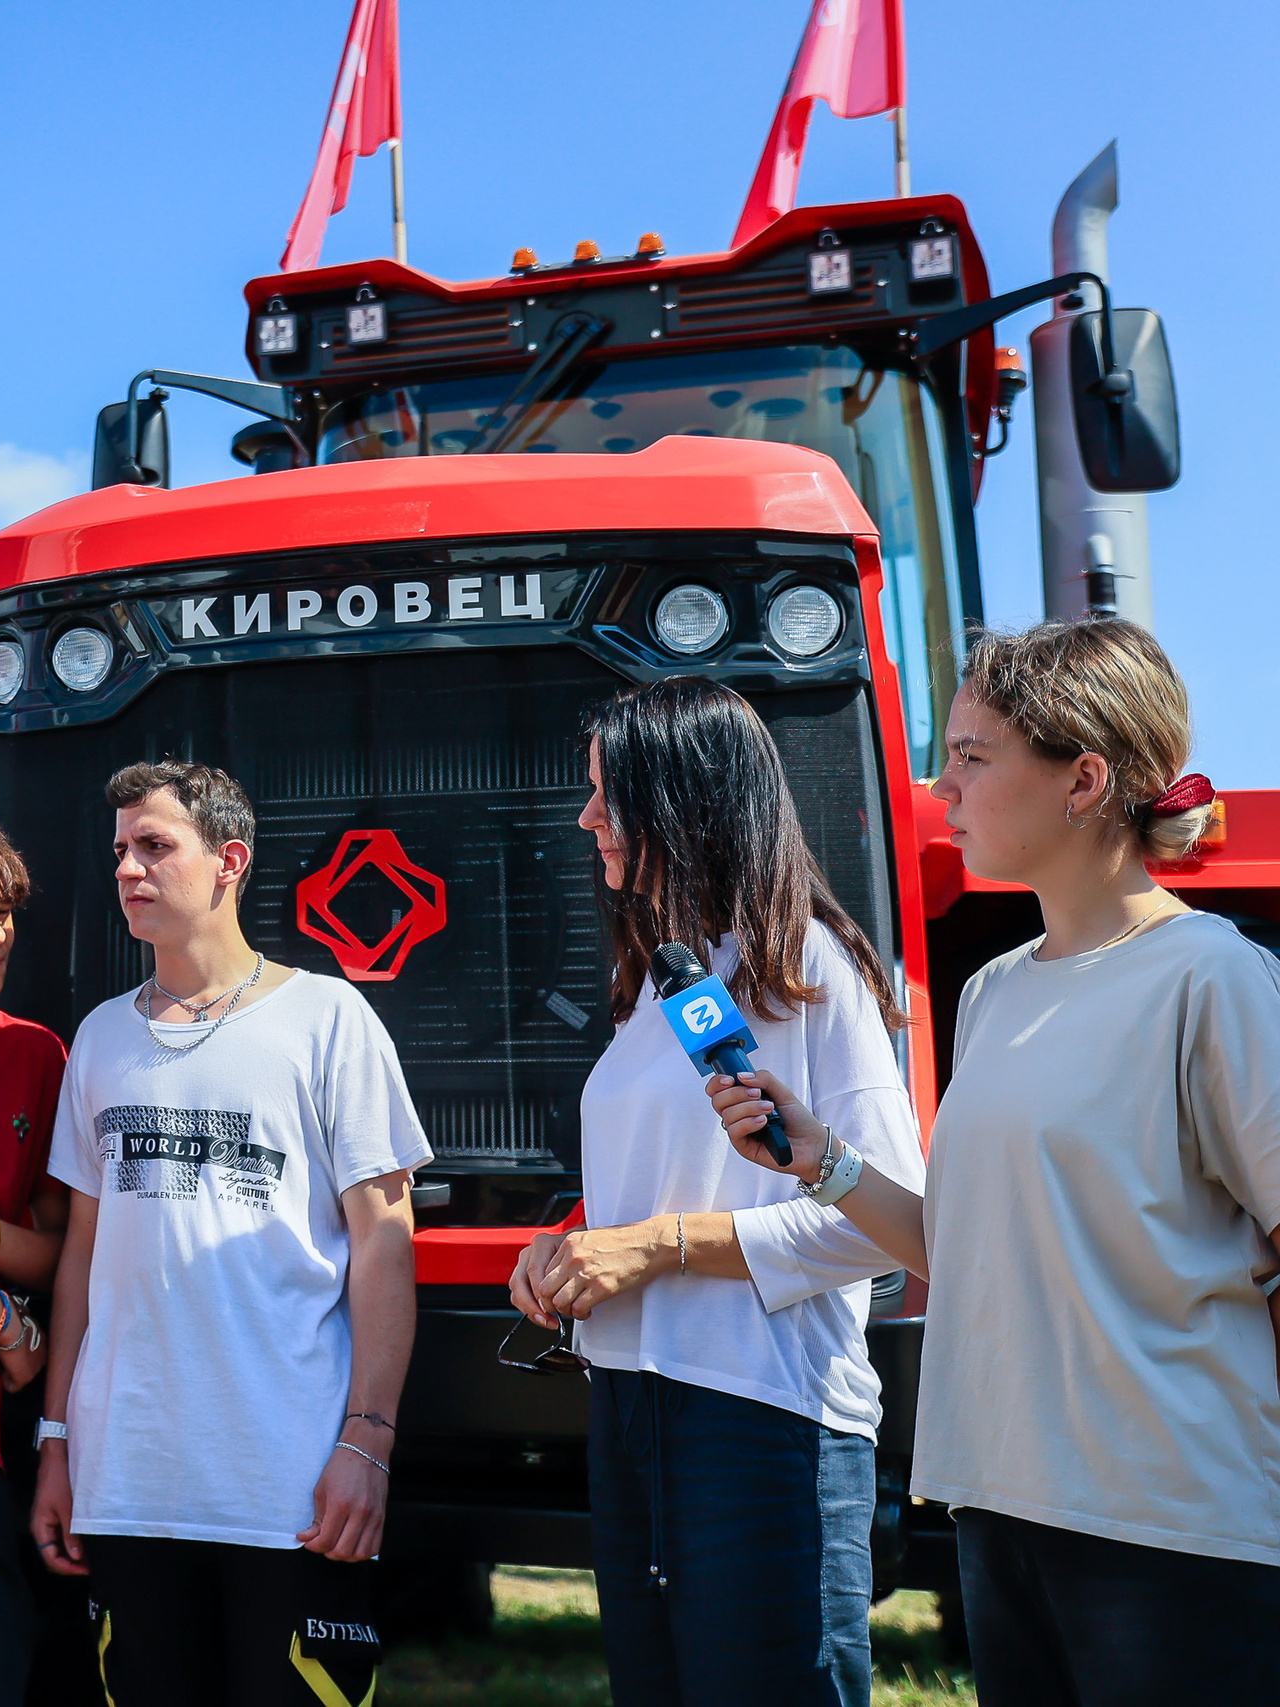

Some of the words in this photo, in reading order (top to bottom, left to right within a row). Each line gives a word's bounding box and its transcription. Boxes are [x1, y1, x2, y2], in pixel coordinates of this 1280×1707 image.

[181, 573, 546, 639] КИРОВЕЦ
[130, 1137, 201, 1157] WORLD
[205, 1138, 279, 1178] Denim
[171, 1192, 197, 1201] DENIM
[218, 1193, 276, 1213] APPAREL
[236, 1186, 270, 1200] CULTURE
